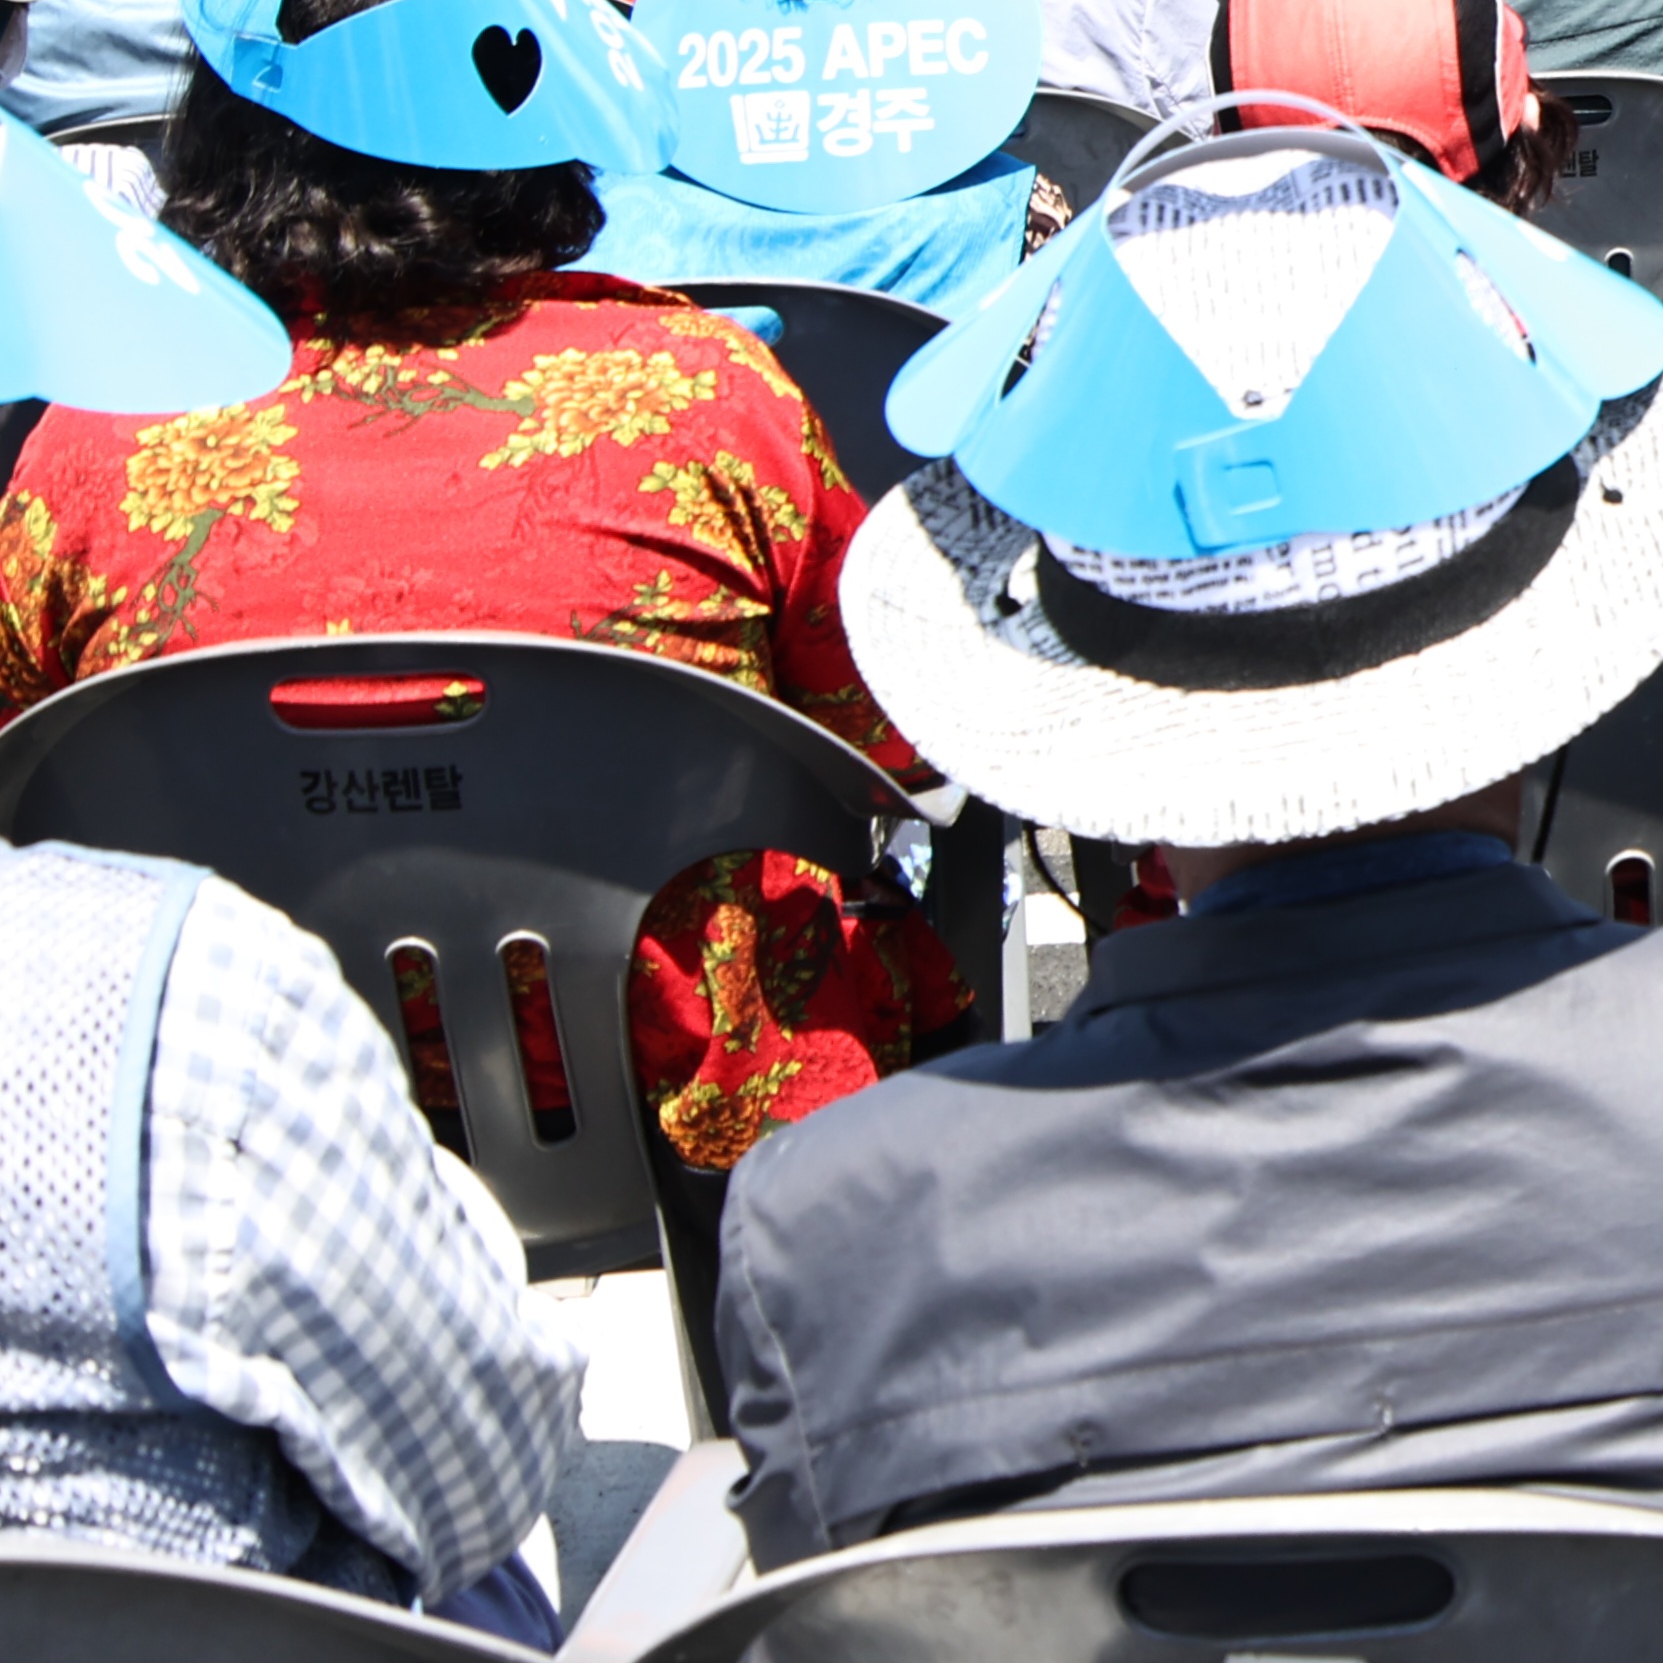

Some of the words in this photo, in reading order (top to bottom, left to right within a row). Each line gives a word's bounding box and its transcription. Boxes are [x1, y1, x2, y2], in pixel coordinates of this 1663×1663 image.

[678, 26, 806, 90] 2025
[821, 17, 990, 81] APEC
[816, 86, 936, 158] 경주
[299, 764, 464, 815] 강산렌탈
